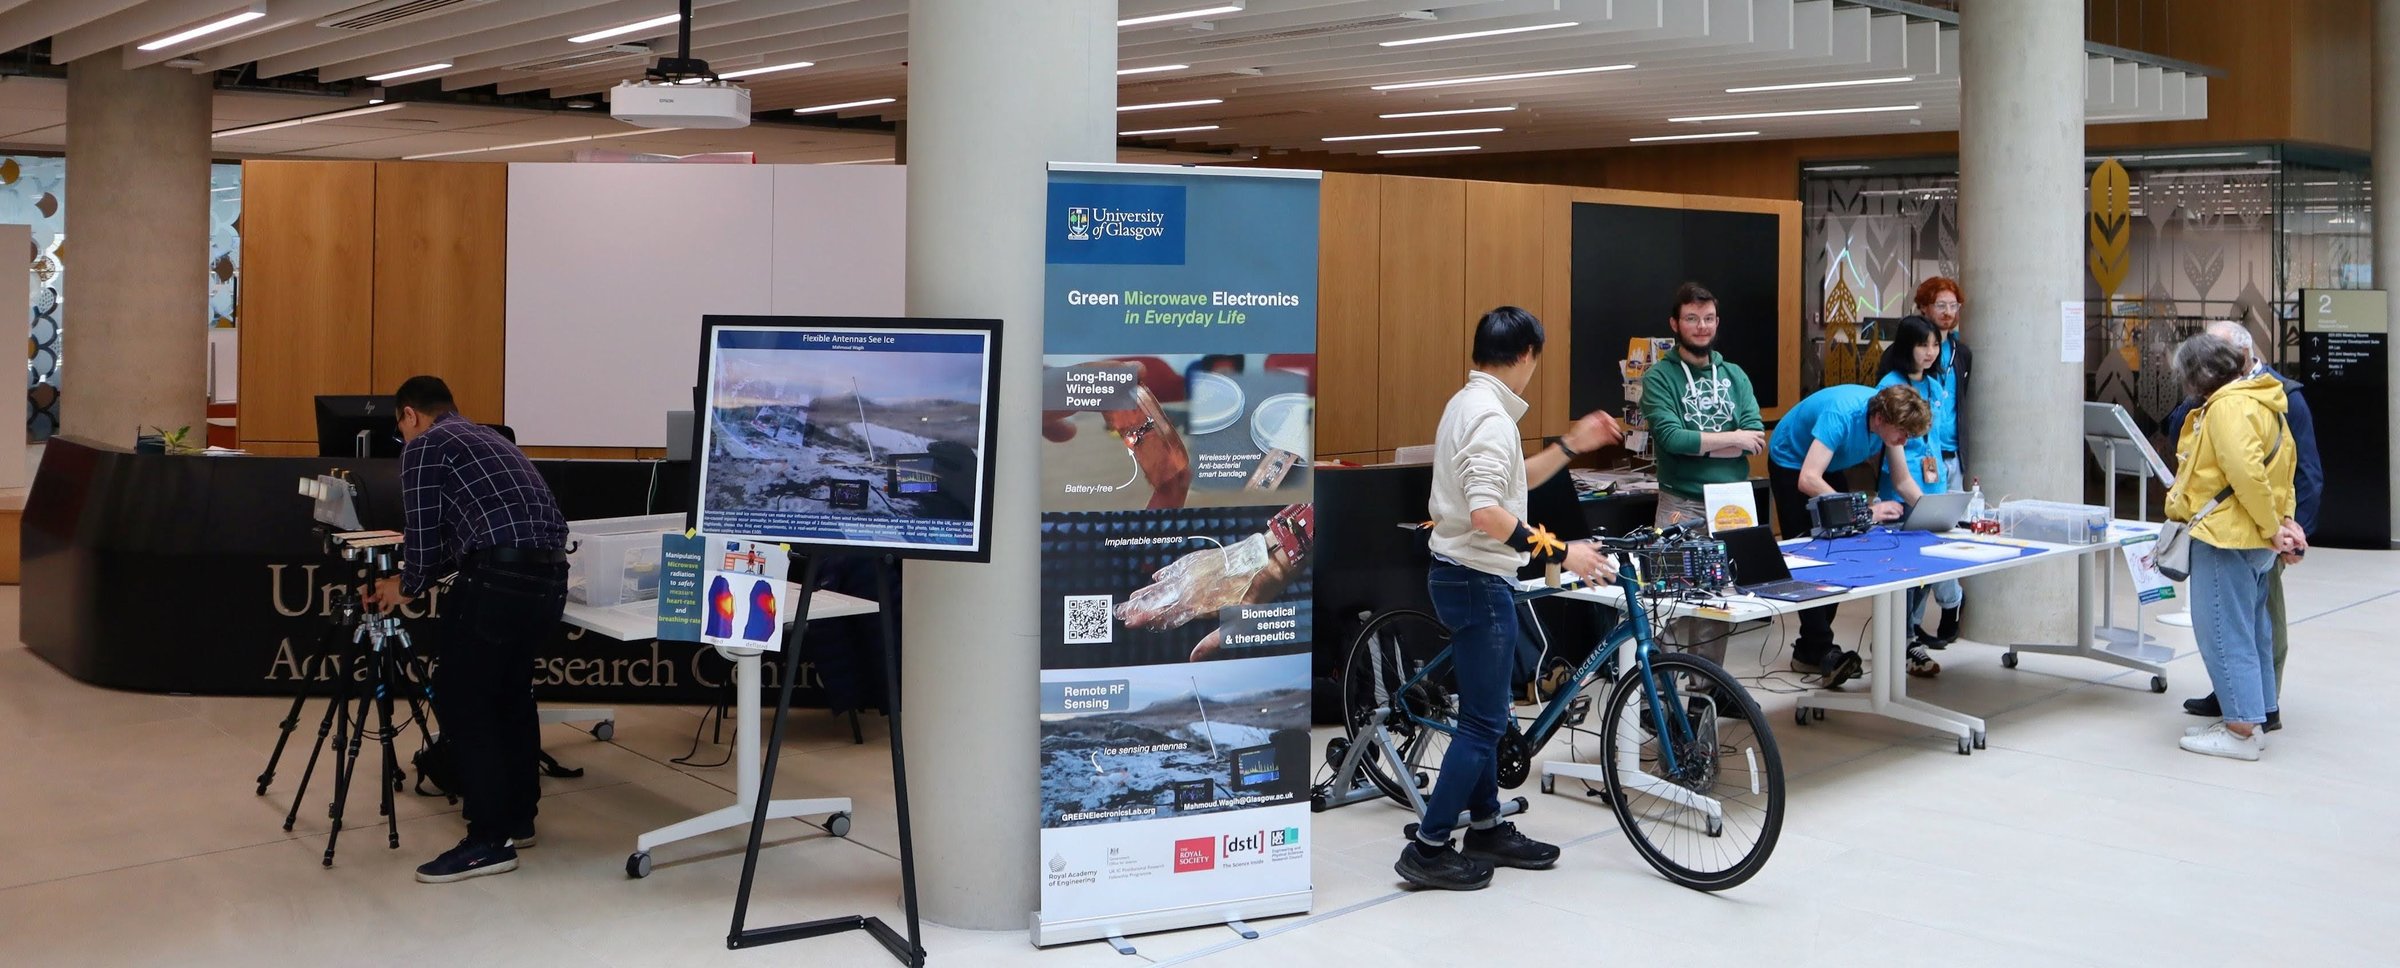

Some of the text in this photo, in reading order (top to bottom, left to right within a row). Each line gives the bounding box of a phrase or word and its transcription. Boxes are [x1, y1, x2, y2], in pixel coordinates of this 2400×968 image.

[1092, 208, 1164, 223] University
[1092, 222, 1164, 240] of Glasgow
[1068, 290, 1299, 306] Green Microwave Electronics
[2319, 295, 2331, 314] 2
[1124, 310, 1246, 328] in Everyday Life
[802, 334, 830, 342] Flexible
[832, 335, 866, 343] Antennas
[868, 336, 882, 344] See
[1066, 372, 1133, 384] Long-Range
[1066, 384, 1114, 394] Wireless
[1066, 396, 1102, 406] Power
[1198, 453, 1262, 463] Wirelessly powered
[1198, 462, 1241, 470] Anti-bacterial
[1218, 470, 1247, 480] bandage
[1064, 483, 1113, 494] Battery-free
[1104, 536, 1183, 547] Implantable sensors
[666, 552, 701, 562] Manipulating
[678, 580, 694, 588] safely
[1242, 606, 1296, 620] Biomedical
[1257, 620, 1296, 630] sensors
[1226, 630, 1296, 645] & therapeutics
[531, 641, 679, 688] esearch
[1572, 640, 1608, 682] RIDGEBACK
[1064, 684, 1124, 697] Remote RF
[1064, 697, 1109, 710] Sensing
[1104, 742, 1188, 756] Ice sensing antennas
[1184, 792, 1294, 810] Mahmoud.Wagih@Glasgow.ac.uk
[1062, 806, 1156, 822] GREENElectronicsLab.org
[1179, 856, 1210, 865] SOCIETY
[1068, 870, 1098, 879] Academy
[1056, 877, 1096, 887] Engineering
